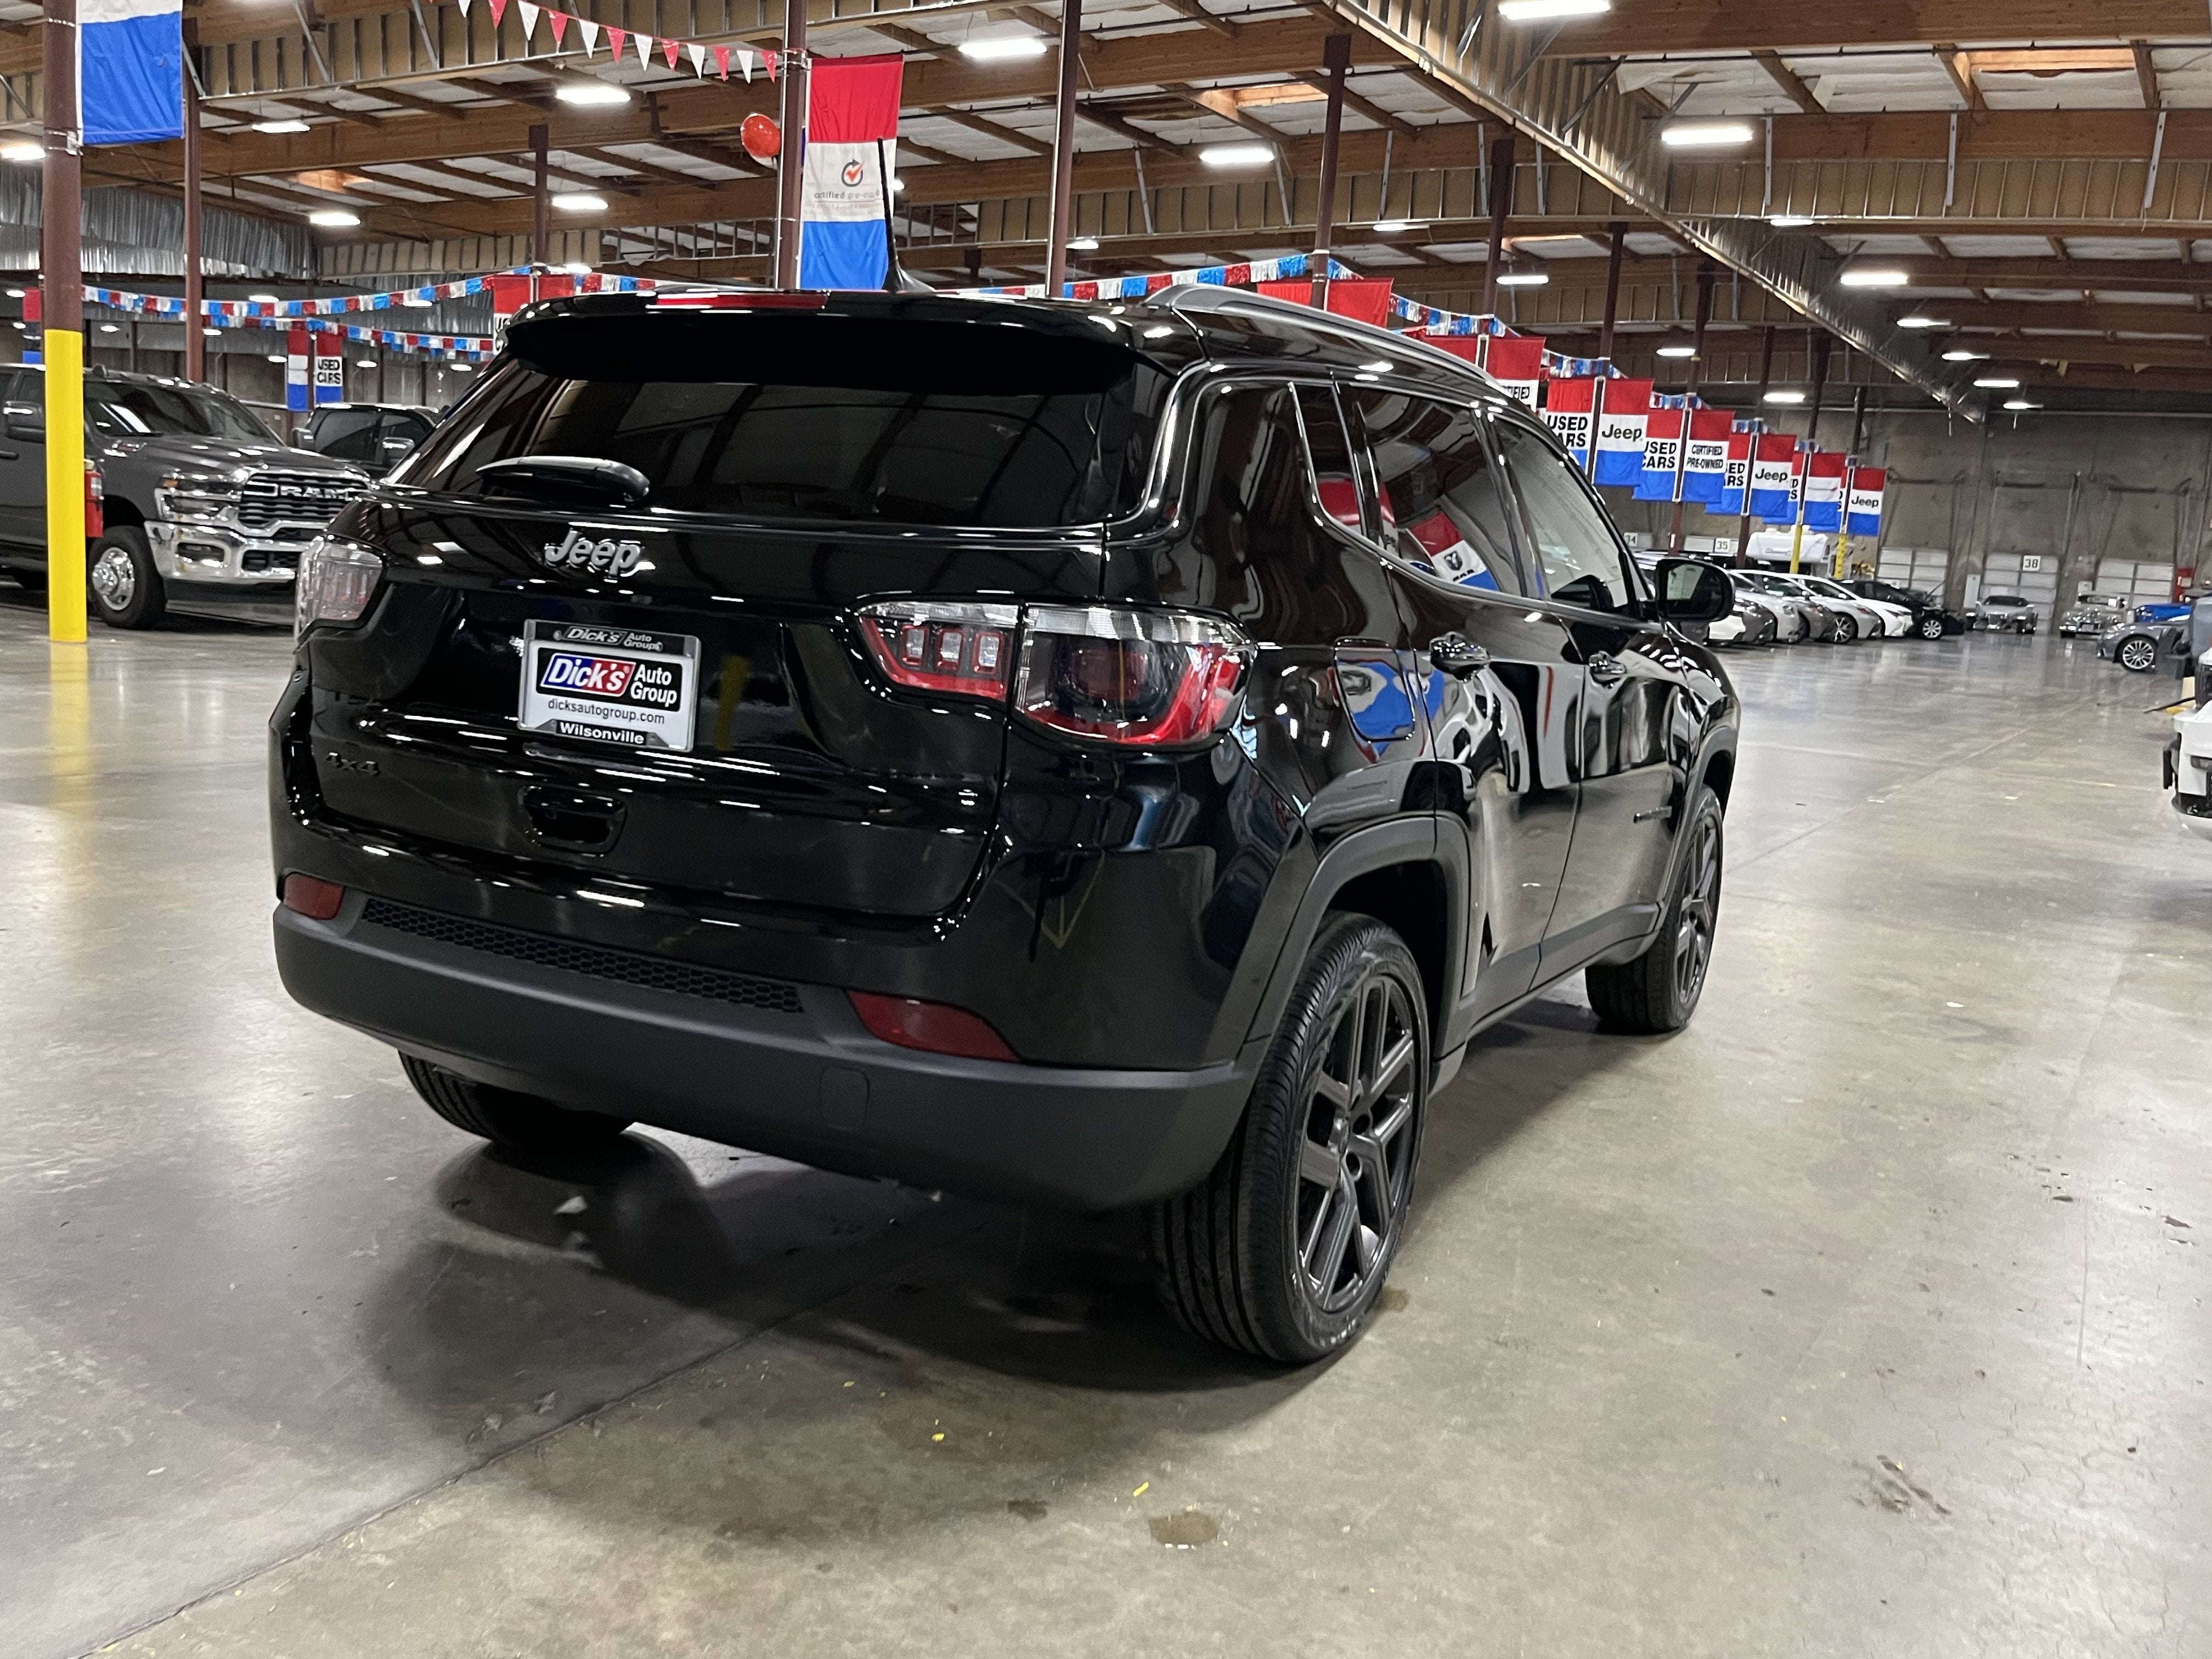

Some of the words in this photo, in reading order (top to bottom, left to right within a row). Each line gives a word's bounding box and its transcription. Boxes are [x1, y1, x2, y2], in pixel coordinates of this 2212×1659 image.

[318, 359, 340, 371] USED
[1547, 415, 1588, 431] USED
[1558, 432, 1586, 447] ARS
[1601, 424, 1642, 442] Jeep
[1754, 468, 1788, 483] Jeep
[280, 486, 346, 500] RAM
[1851, 495, 1879, 508] Jeep
[1717, 541, 1728, 549] 35
[544, 529, 641, 578] Jeep
[2025, 558, 2039, 568] 38
[628, 633, 652, 642] Auto
[634, 664, 672, 685] Auto
[630, 681, 678, 707] Group
[548, 698, 665, 724] dicksautogroup.com
[560, 721, 645, 744] Wilsonville
